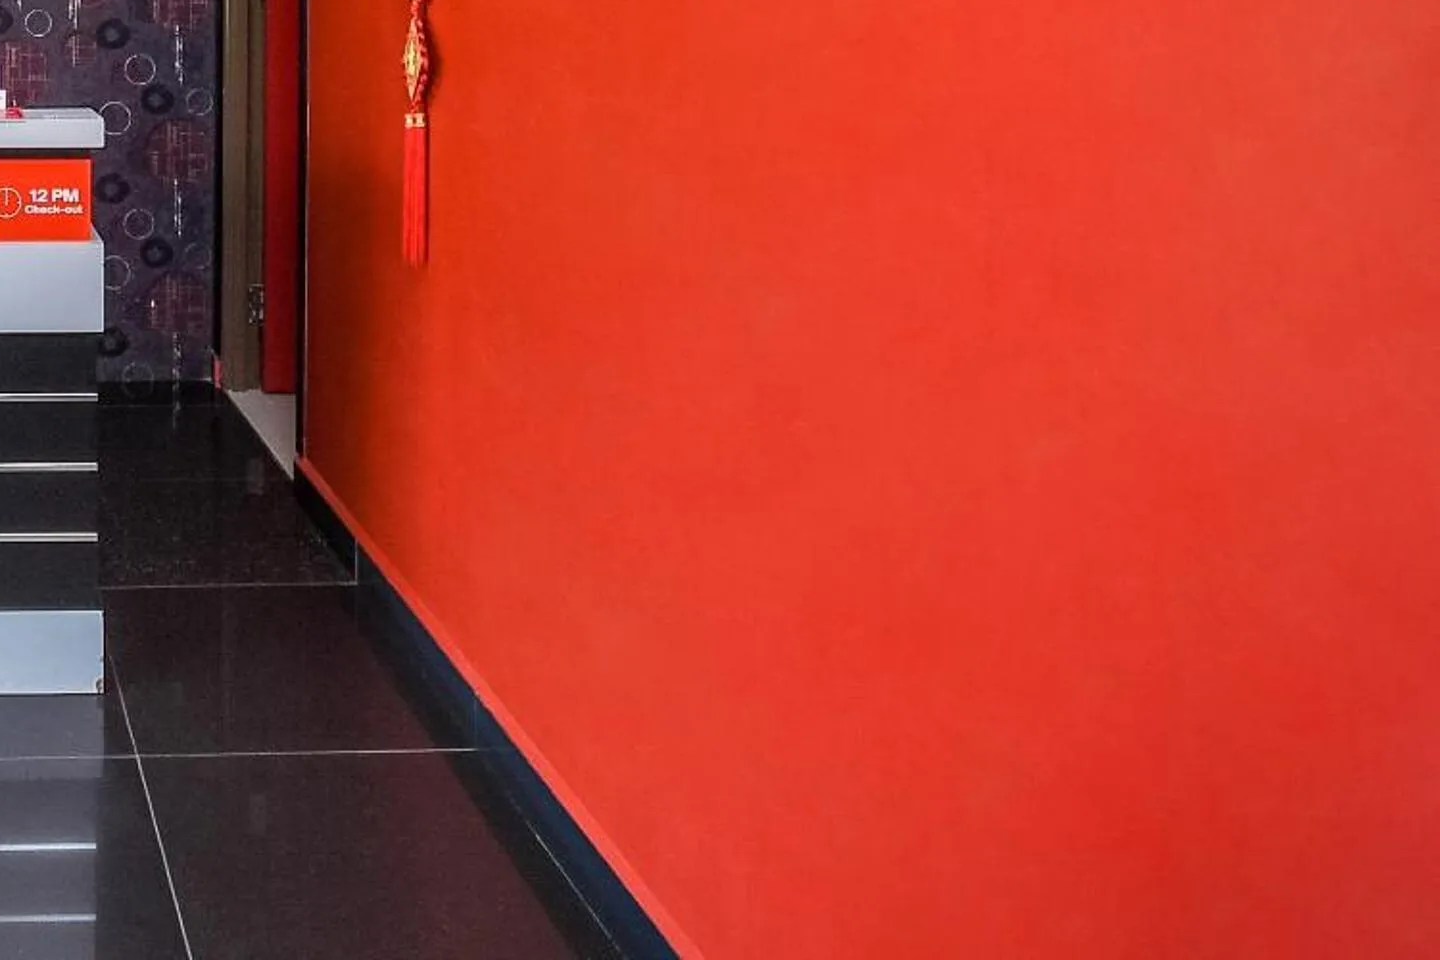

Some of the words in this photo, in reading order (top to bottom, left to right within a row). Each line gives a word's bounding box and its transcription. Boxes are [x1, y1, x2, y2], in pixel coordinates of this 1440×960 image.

[29, 189, 48, 203] 12
[52, 188, 79, 203] PM
[25, 204, 83, 215] Check-out
